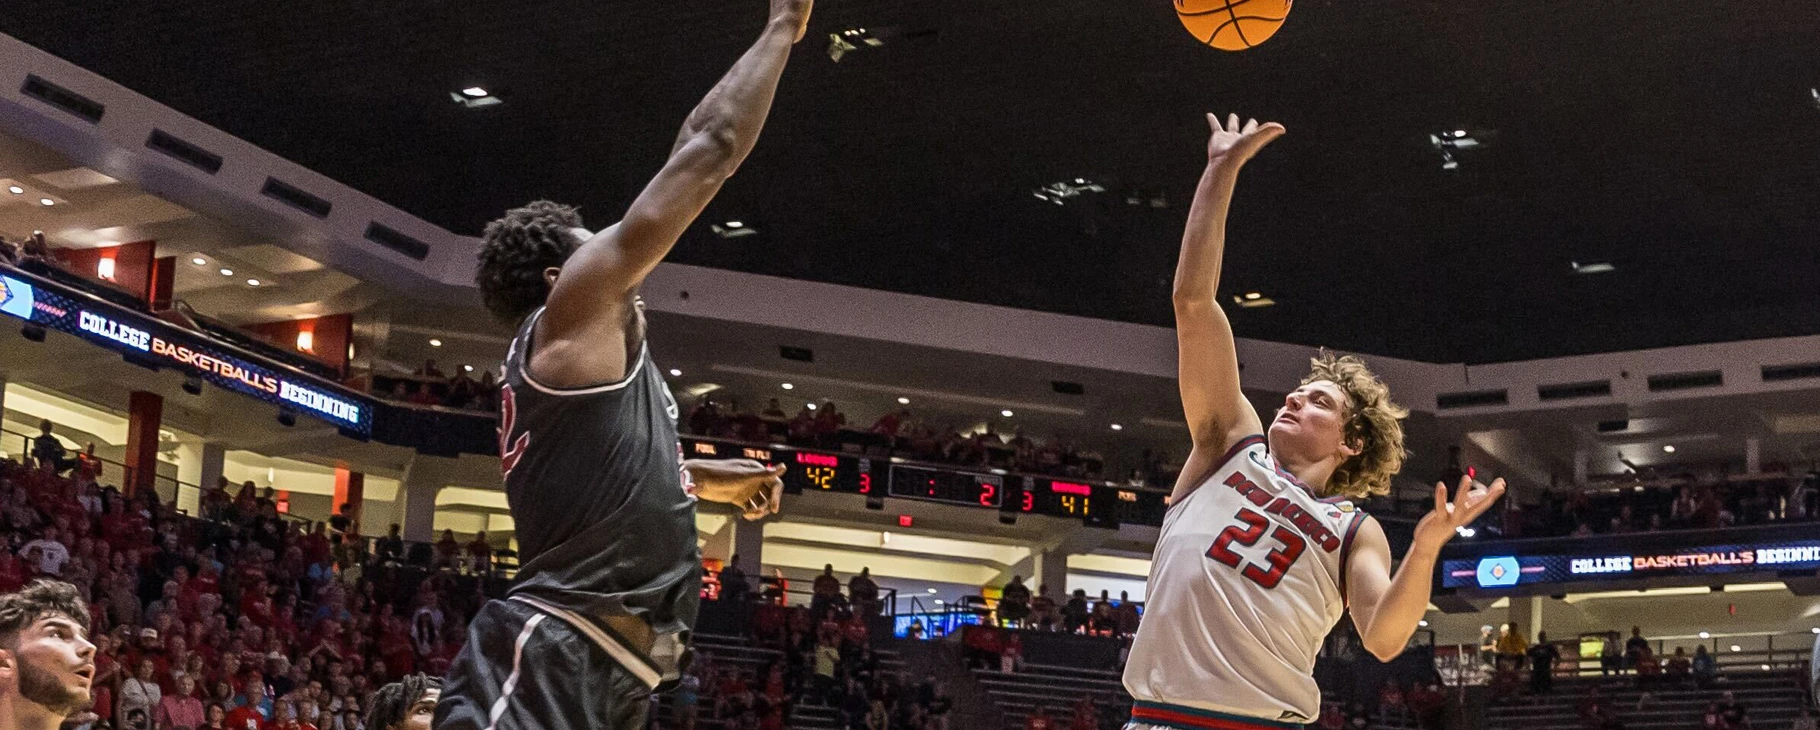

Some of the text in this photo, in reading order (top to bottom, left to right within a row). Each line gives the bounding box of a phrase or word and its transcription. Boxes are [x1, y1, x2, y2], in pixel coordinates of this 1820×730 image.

[79, 310, 359, 424] COLLEGE BASKETBALL'S BEGINNING
[806, 467, 836, 489] 42
[859, 473, 871, 493] 3
[979, 483, 995, 506] 2
[1022, 491, 1033, 511] 3
[1061, 495, 1089, 516] 41
[1205, 507, 1307, 589] 23
[1571, 557, 1632, 573] COLLEGE
[1633, 551, 1754, 569] BASKETBALL'S
